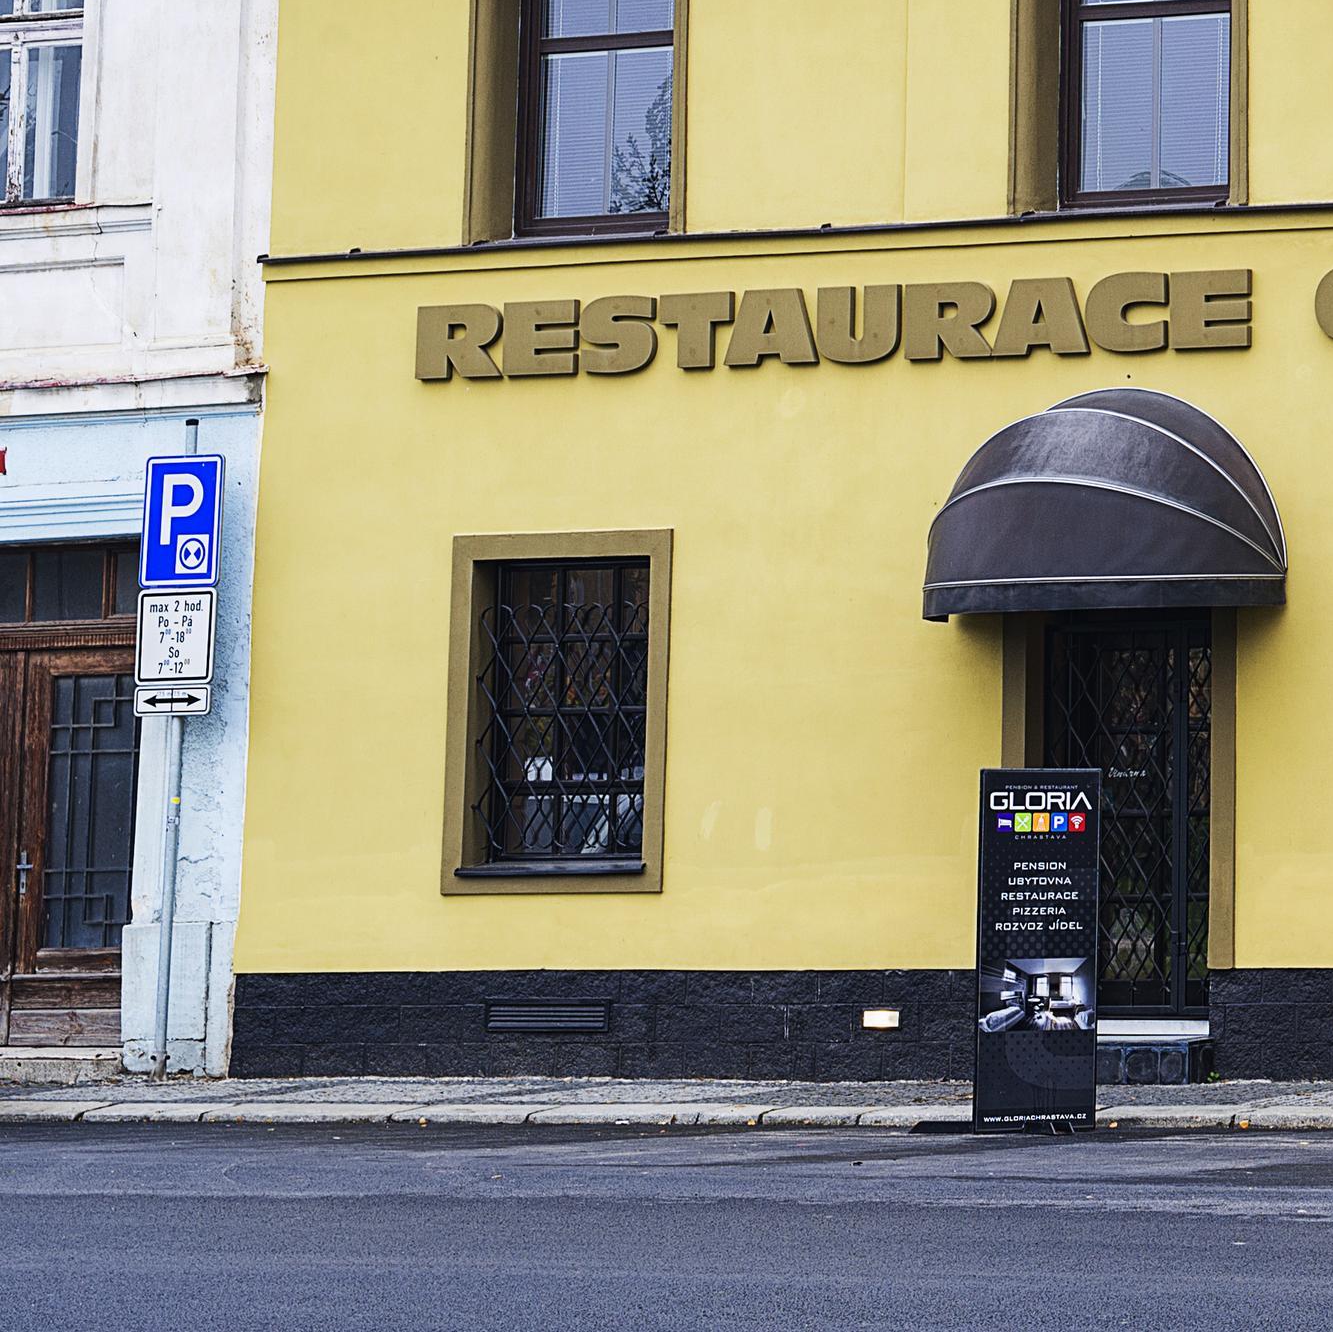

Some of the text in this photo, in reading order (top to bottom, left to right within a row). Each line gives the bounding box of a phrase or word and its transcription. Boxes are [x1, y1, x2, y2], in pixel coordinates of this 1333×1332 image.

[416, 269, 1253, 381] RESTAURACE
[160, 473, 204, 545] P
[149, 600, 203, 613] max 2 hod.
[158, 616, 169, 628] Po
[181, 615, 193, 627] Pá
[168, 646, 180, 658] So
[990, 792, 1092, 810] GLORIA
[1013, 861, 1067, 871] PENSION
[1008, 877, 1071, 885] UBYTOVNA
[1001, 891, 1079, 901] RESTAURACE
[1012, 907, 1067, 916] PIZZERIA
[995, 918, 1084, 931] ROZVOZ JÍDEL
[984, 1114, 1086, 1122] WWW.GLORIACHRASTAVA.CZ
